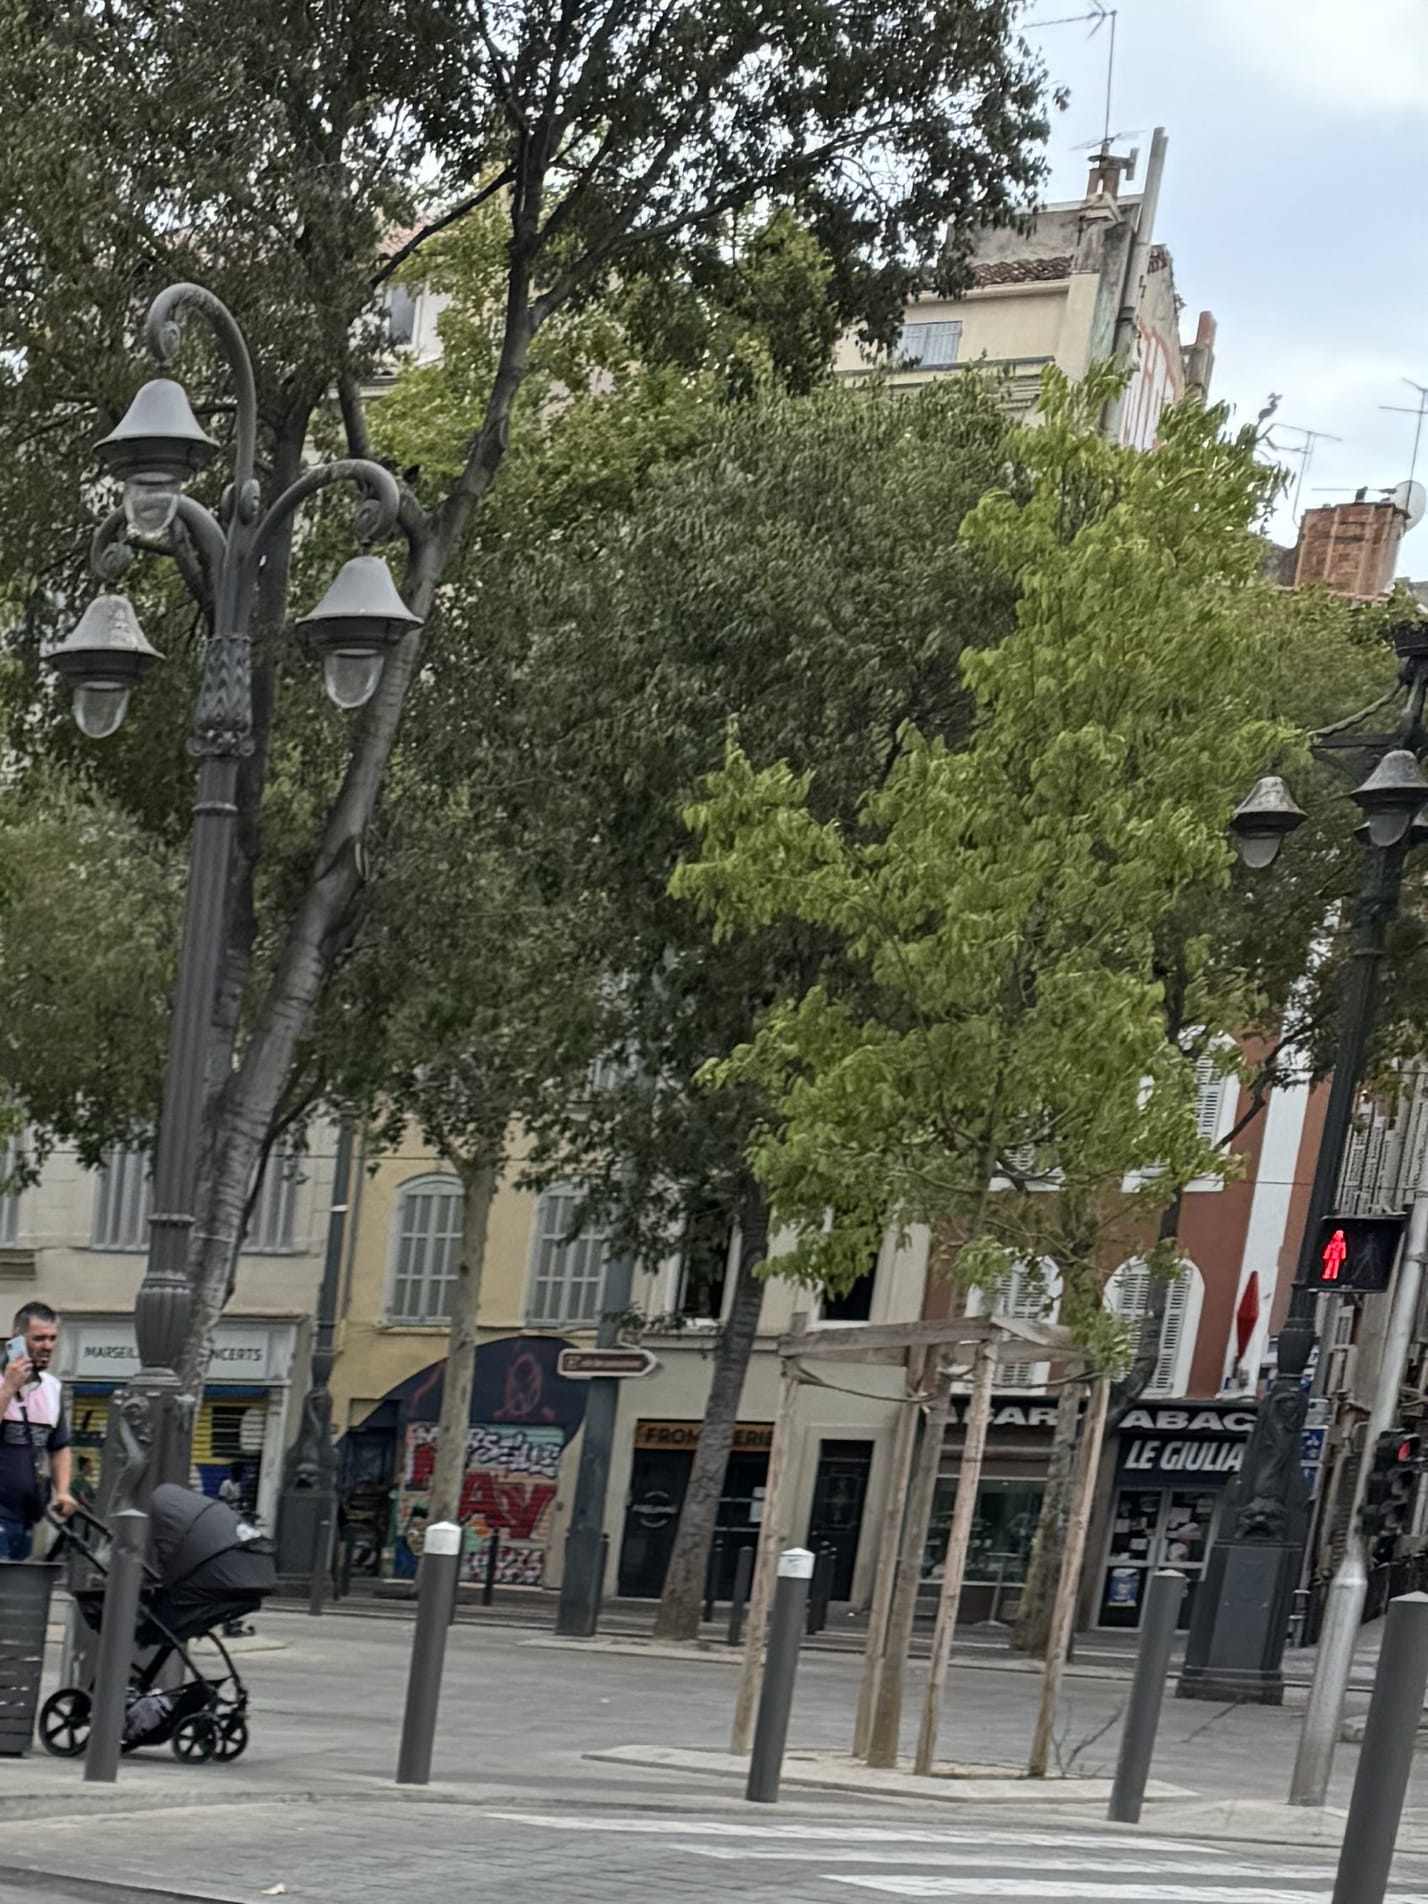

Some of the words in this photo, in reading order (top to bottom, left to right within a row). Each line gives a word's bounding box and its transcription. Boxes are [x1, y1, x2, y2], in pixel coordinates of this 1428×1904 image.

[83, 1346, 139, 1360] MARSEIL
[208, 1347, 263, 1362] NCERTS
[1117, 1409, 1258, 1431] ABAC
[1123, 1440, 1161, 1470] LE
